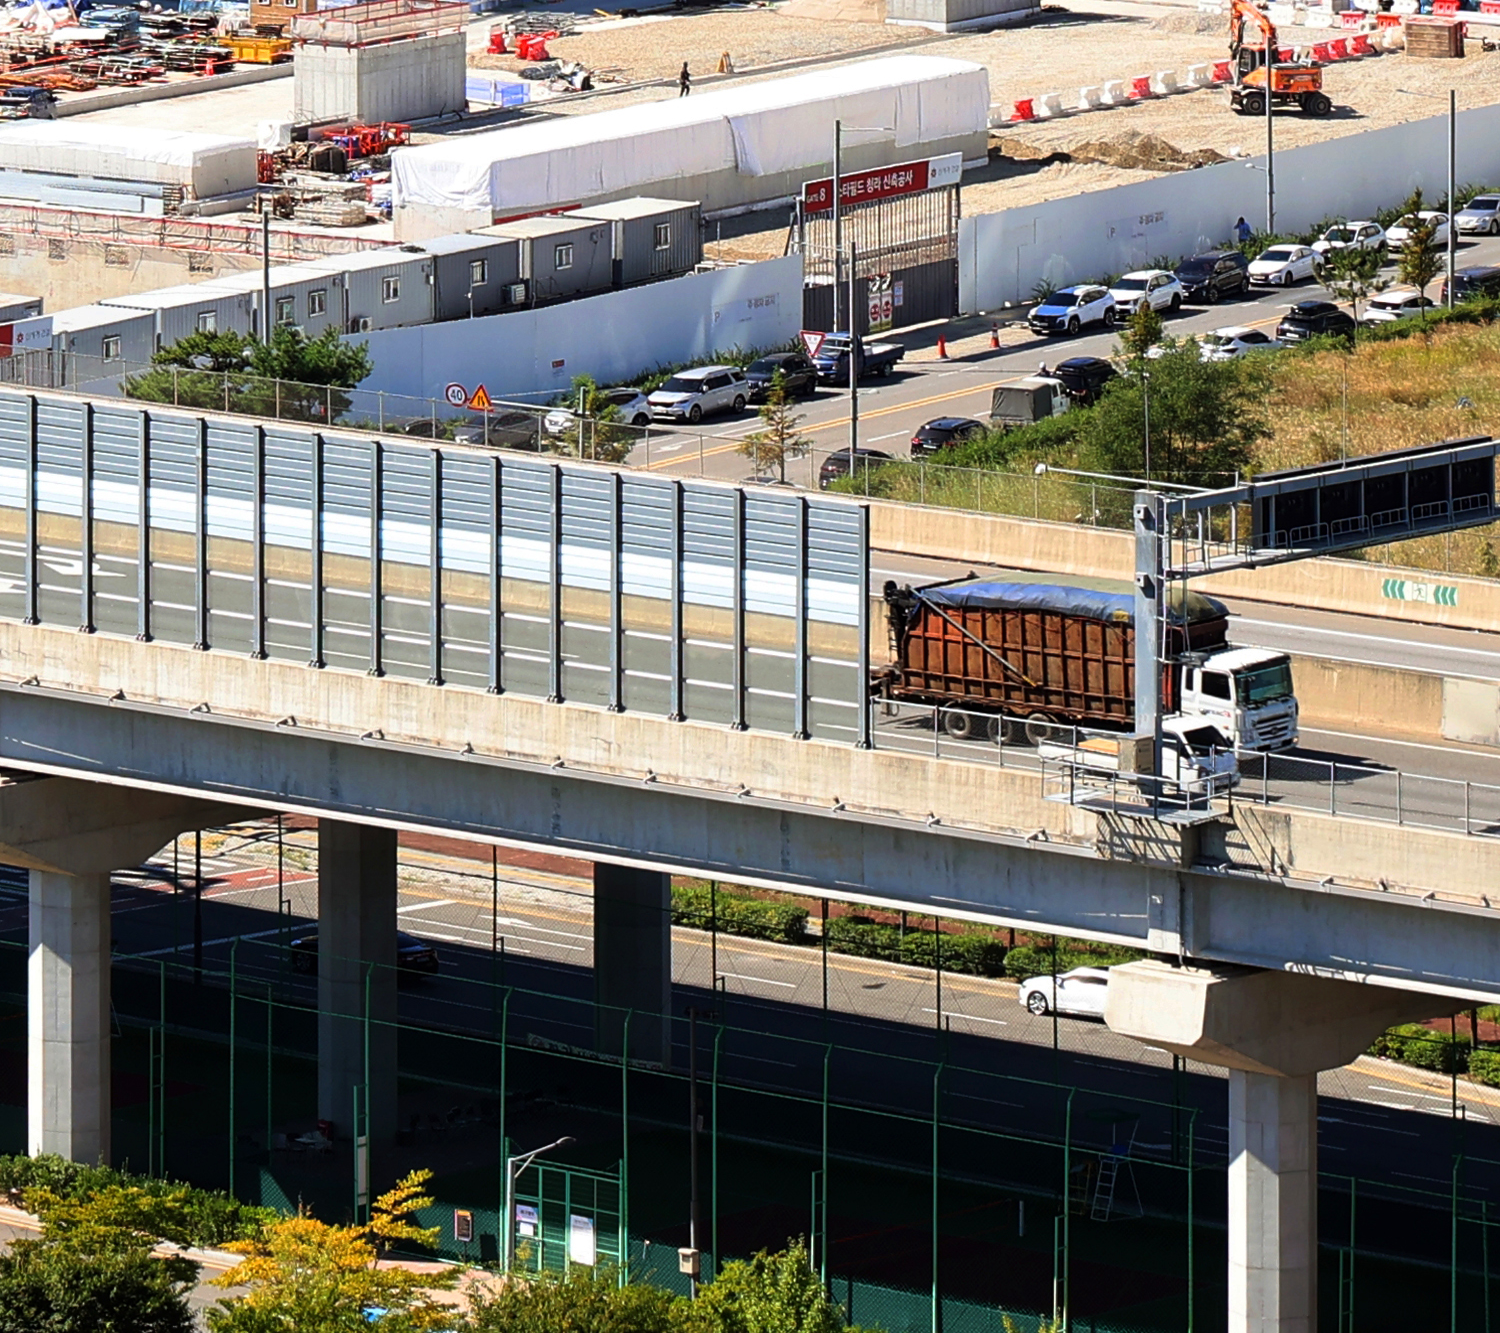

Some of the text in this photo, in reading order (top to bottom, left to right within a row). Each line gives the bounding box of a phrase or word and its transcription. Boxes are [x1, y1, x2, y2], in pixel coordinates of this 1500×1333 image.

[866, 177, 881, 193] 청라
[883, 170, 913, 190] 신축공사
[819, 187, 826, 202] 8
[451, 390, 462, 401] 40
